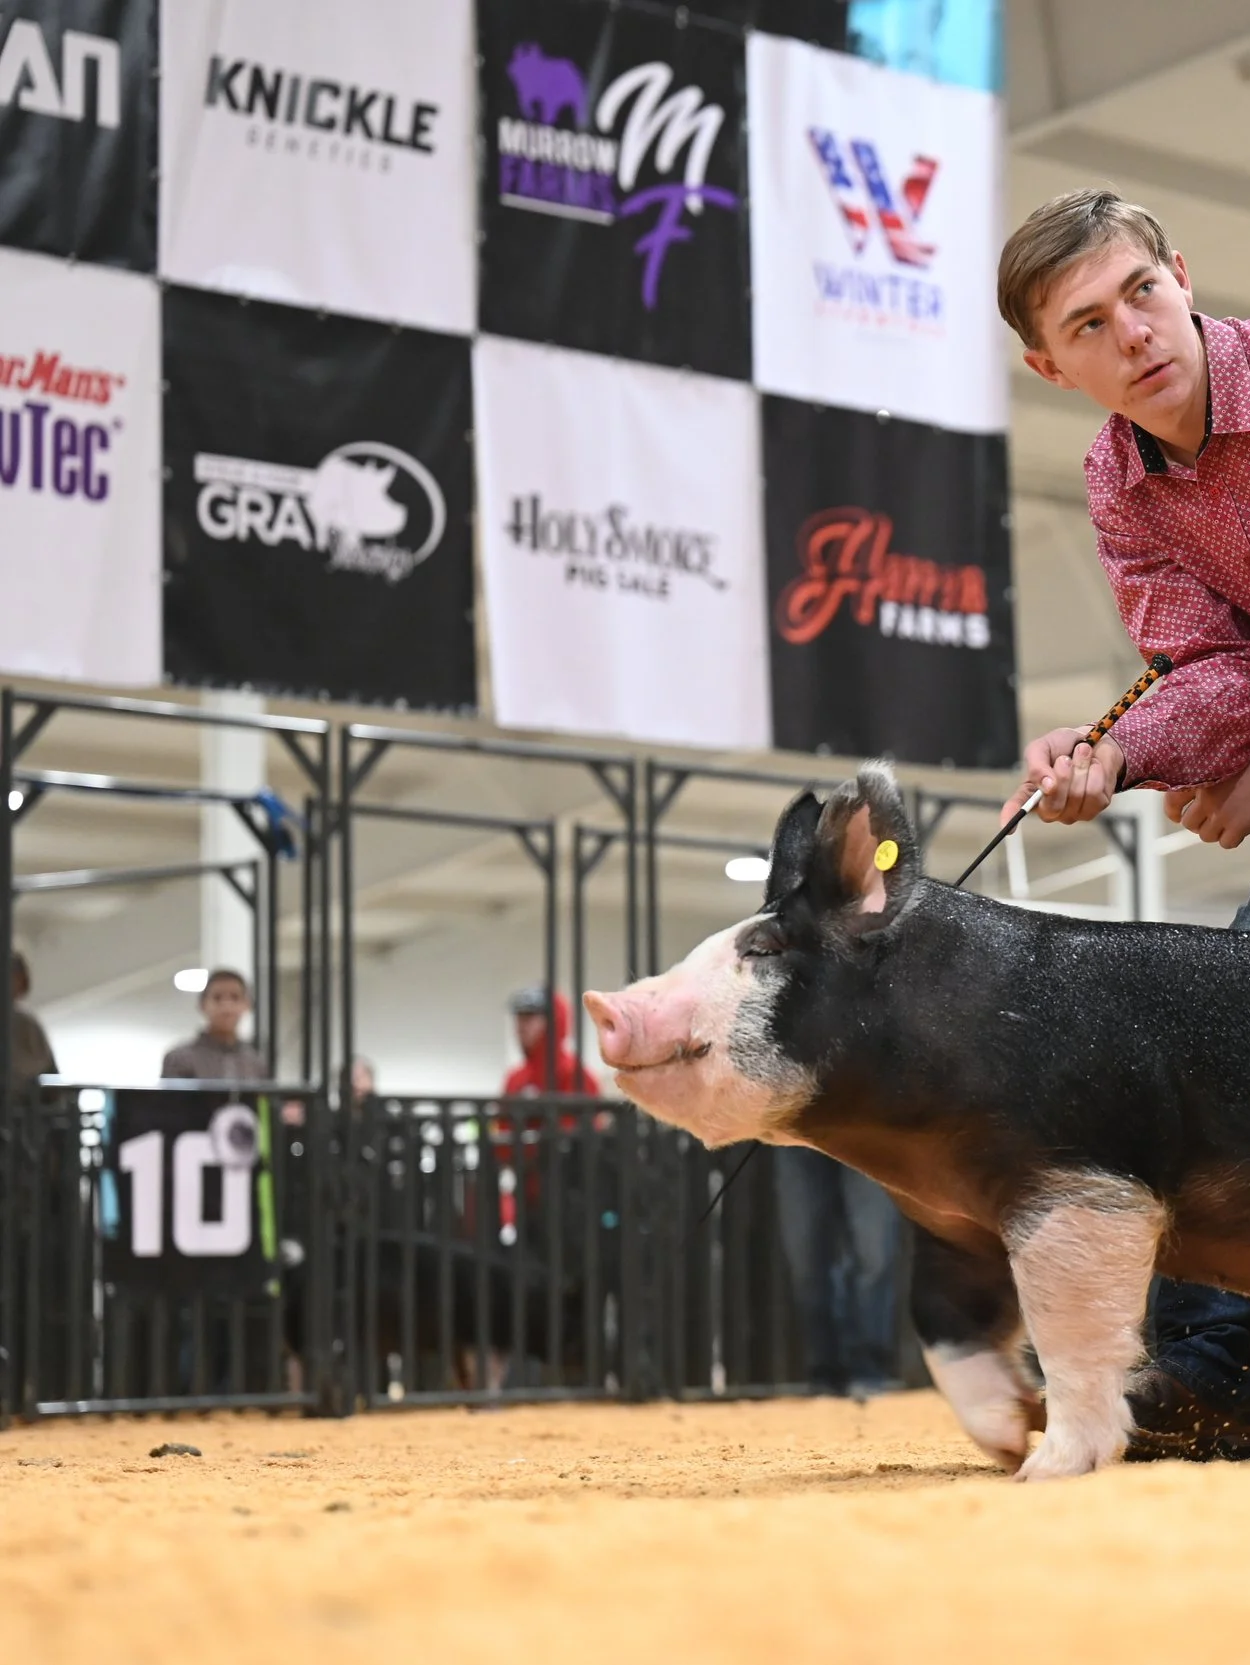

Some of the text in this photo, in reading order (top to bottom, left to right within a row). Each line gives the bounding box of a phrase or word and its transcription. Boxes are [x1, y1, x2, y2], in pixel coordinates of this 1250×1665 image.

[205, 54, 440, 154] KNICKLE
[498, 115, 616, 177] MURROW
[504, 491, 597, 557] HOLY
[879, 599, 990, 649] FARMS
[119, 1130, 252, 1258] 10
